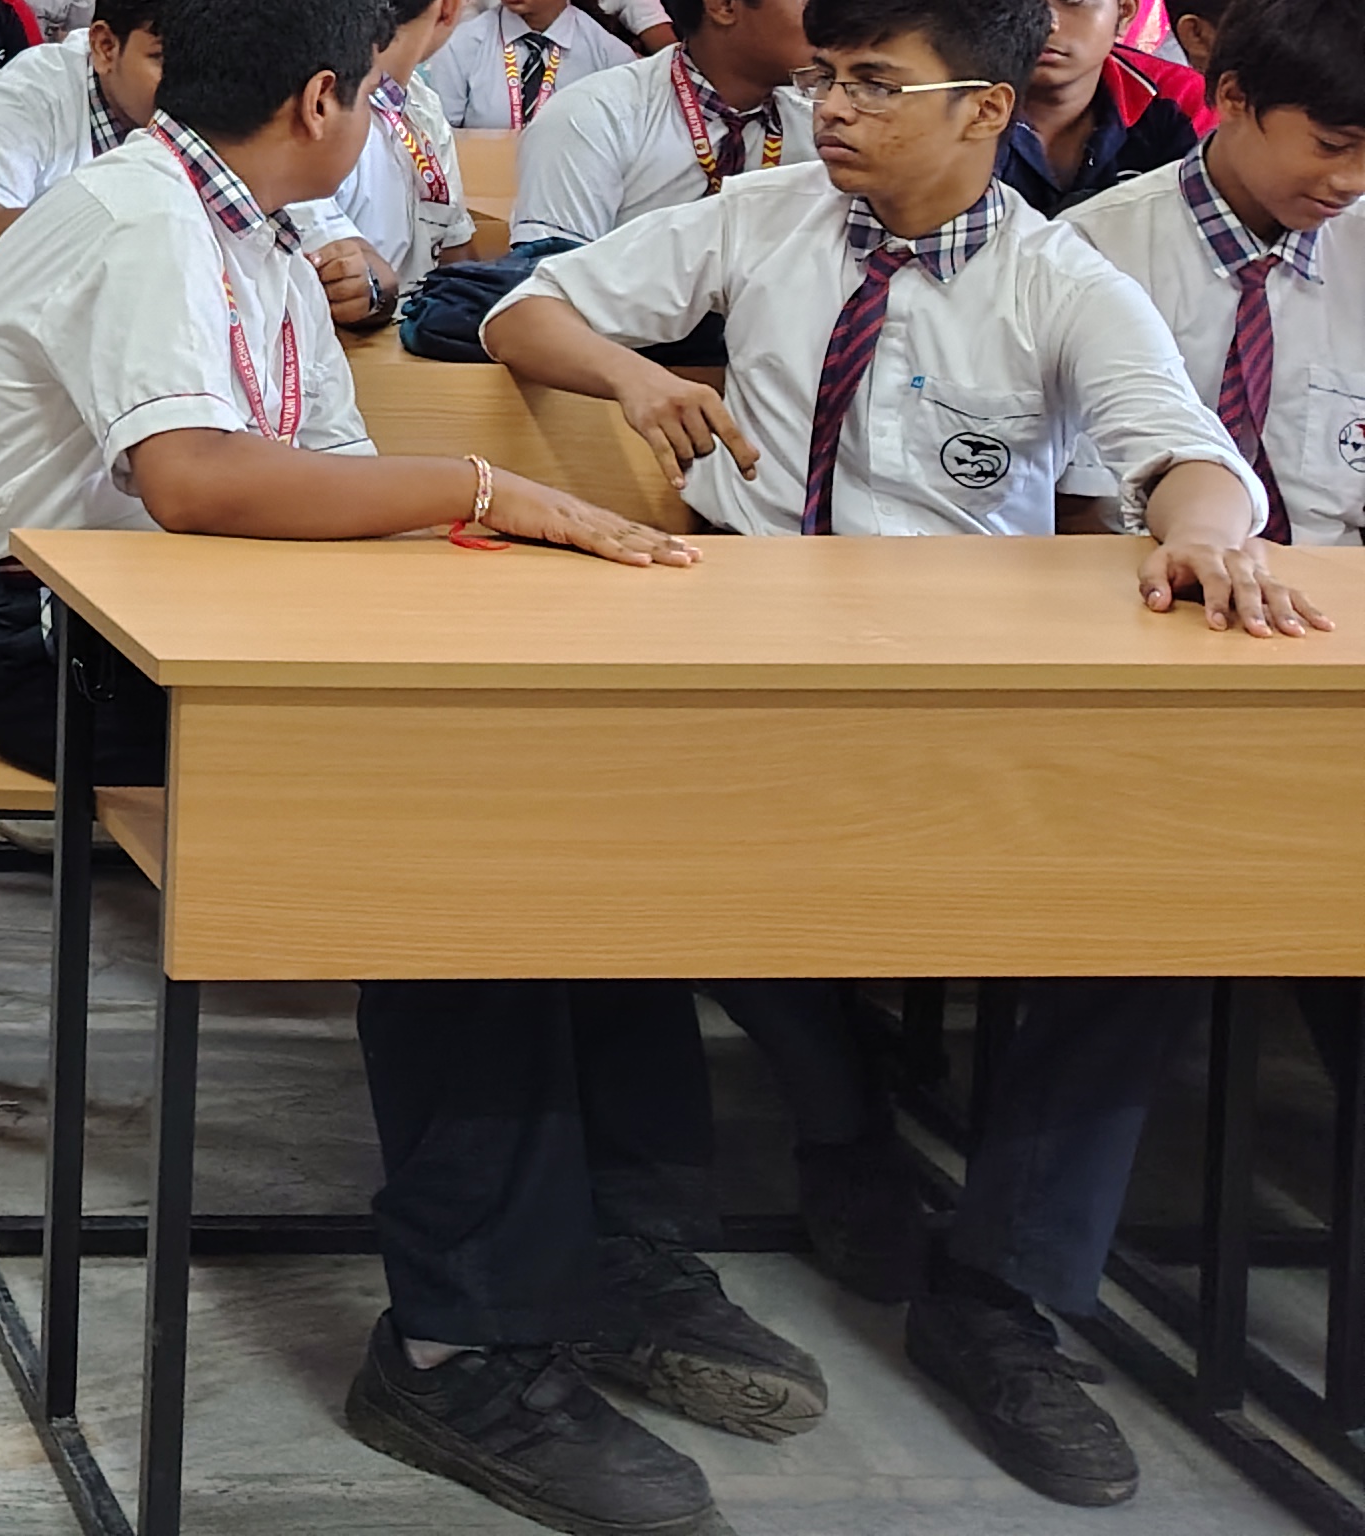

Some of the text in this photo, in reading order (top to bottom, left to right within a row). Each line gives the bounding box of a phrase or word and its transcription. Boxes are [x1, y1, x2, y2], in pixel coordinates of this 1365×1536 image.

[234, 327, 251, 367] SCHOOL
[245, 367, 260, 402] PUBLIC
[285, 363, 296, 396] PUBLIC
